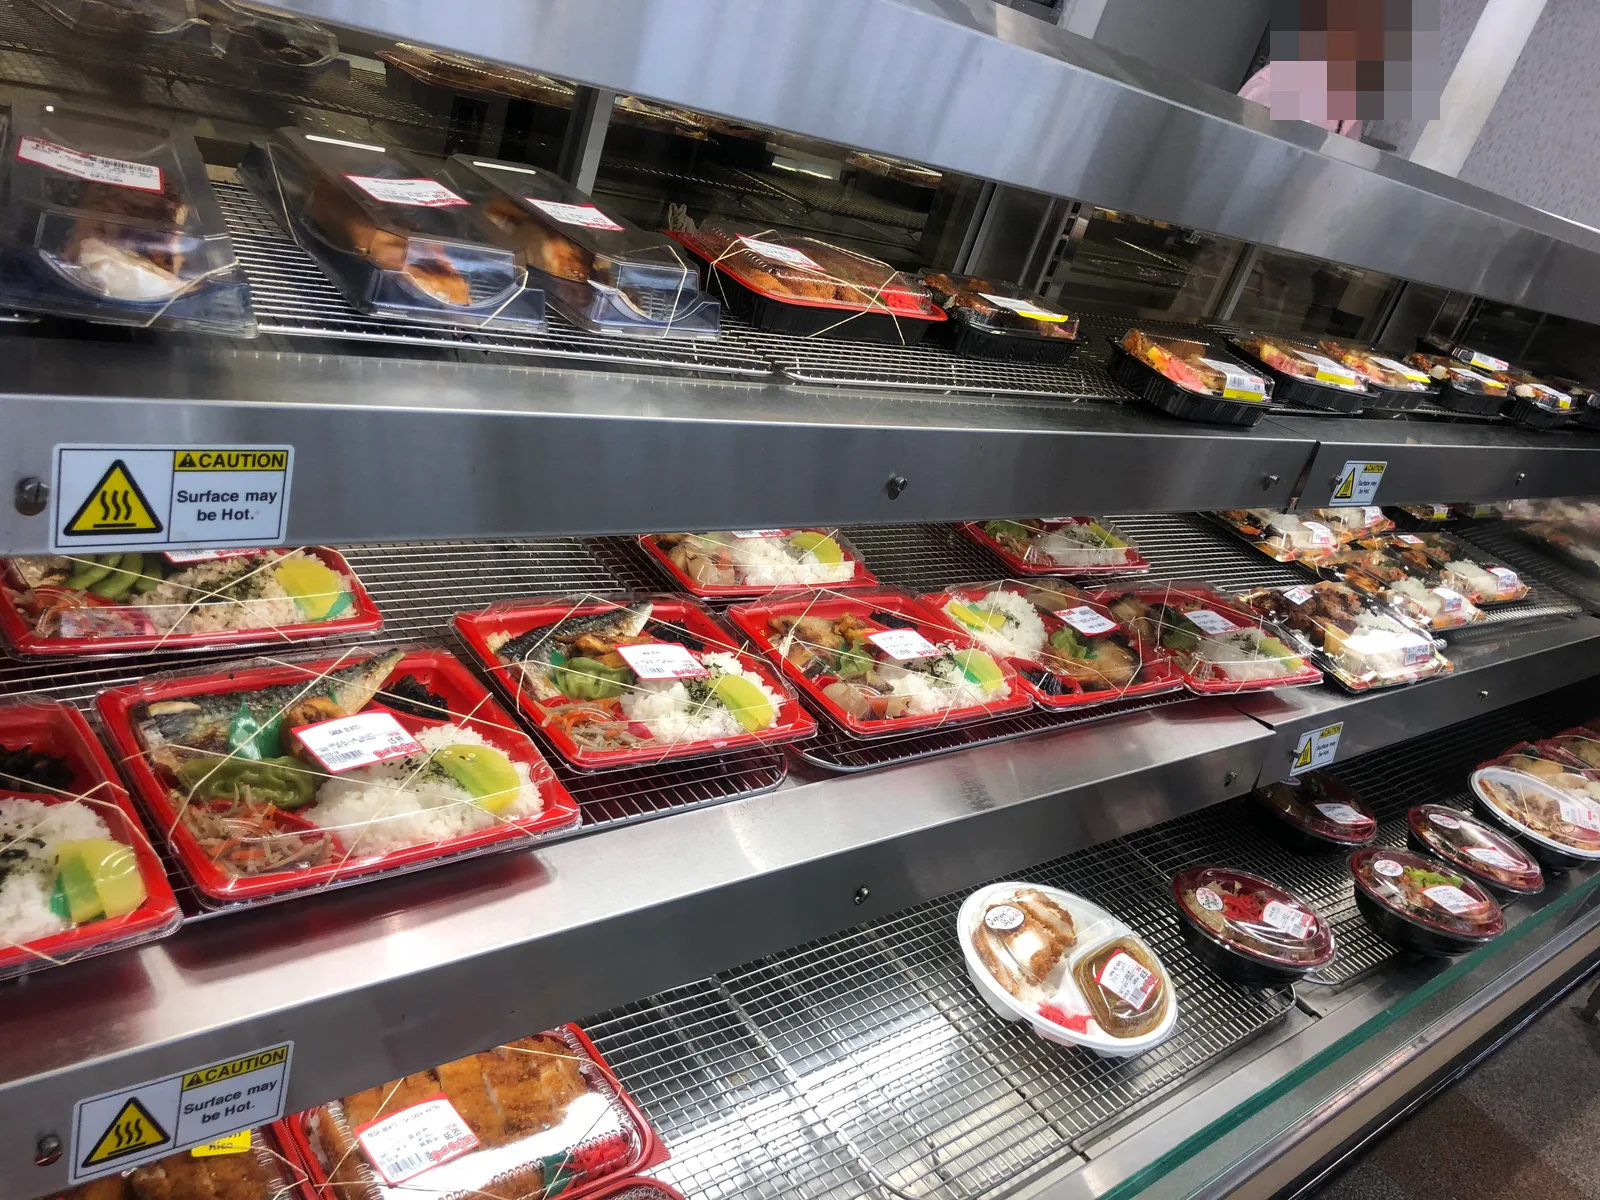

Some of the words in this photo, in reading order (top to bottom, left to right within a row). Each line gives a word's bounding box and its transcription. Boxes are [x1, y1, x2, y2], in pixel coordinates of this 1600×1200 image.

[198, 453, 284, 468] CAUTION
[177, 490, 239, 503] Surface
[245, 491, 278, 504] may
[197, 509, 217, 521] be
[222, 508, 255, 520] Hot.
[205, 1049, 285, 1081] CAUTION
[184, 1091, 242, 1115] Surface
[247, 1080, 278, 1097] may
[201, 1111, 221, 1124] be
[224, 1100, 255, 1117] Hot.
